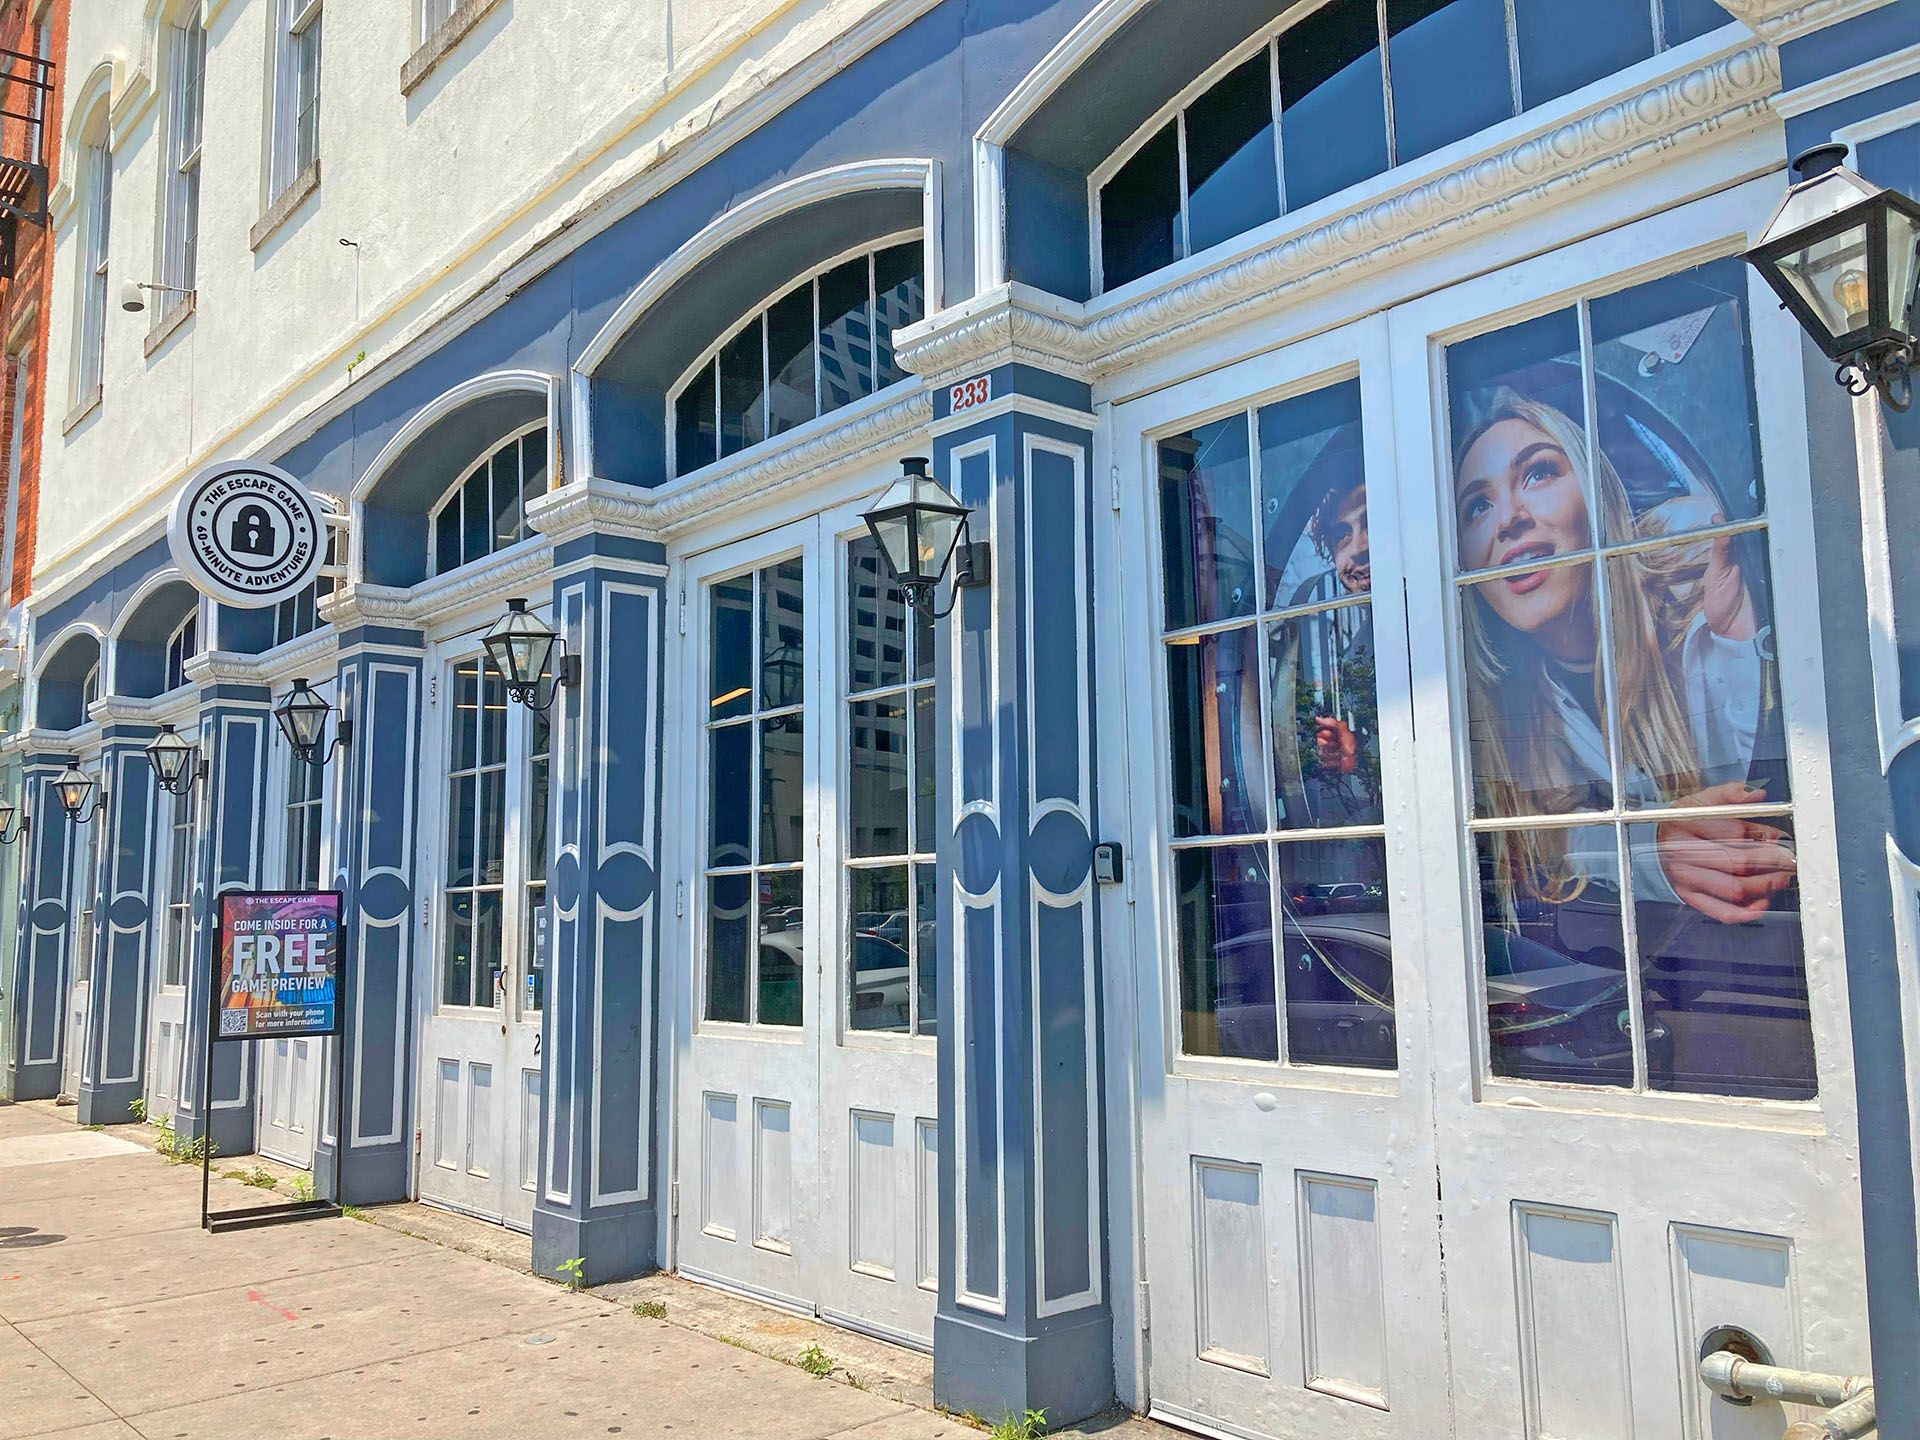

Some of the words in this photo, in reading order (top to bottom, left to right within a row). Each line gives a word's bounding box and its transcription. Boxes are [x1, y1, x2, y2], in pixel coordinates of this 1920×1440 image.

[953, 378, 988, 412] 233
[204, 485, 227, 505] THE
[226, 478, 276, 494] ESCAPE
[277, 490, 305, 521] GAME
[196, 525, 243, 583] 60-MINUTE
[245, 541, 308, 586] ADVENTURES
[234, 920, 262, 931] COME
[264, 919, 297, 931] INSIDE
[299, 919, 319, 930] FOR
[320, 918, 327, 929] A
[232, 934, 327, 975] FREE
[232, 979, 267, 993] GAME
[271, 977, 325, 991] PREVIEW
[255, 1010, 272, 1018] Scan
[273, 1009, 288, 1018] with
[289, 1010, 303, 1019] your
[305, 1008, 325, 1018] phone
[255, 1020, 265, 1028] for
[266, 1020, 284, 1028] more
[285, 1017, 325, 1027] information!
